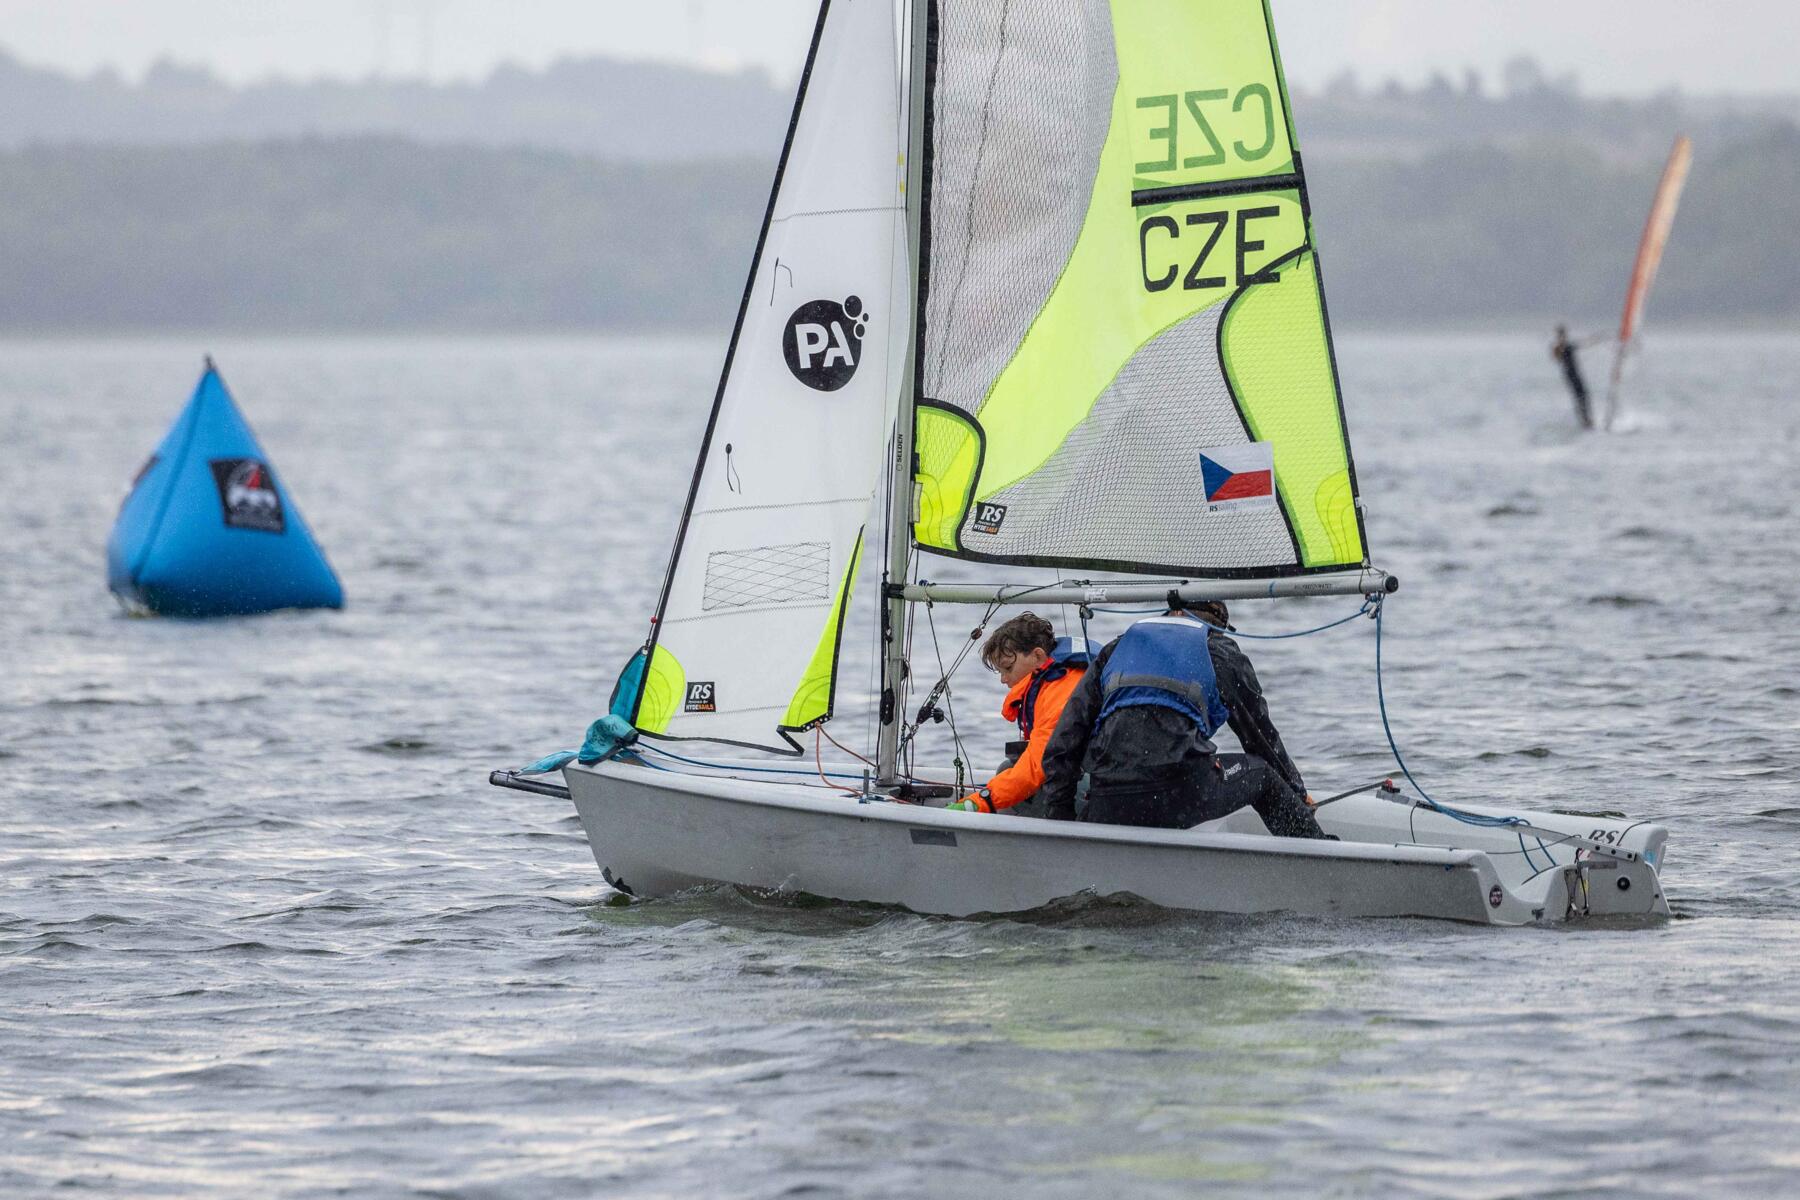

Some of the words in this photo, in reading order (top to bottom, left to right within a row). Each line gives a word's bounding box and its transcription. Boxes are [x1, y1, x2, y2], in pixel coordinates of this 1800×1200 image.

[1139, 205, 1281, 293] CZE
[795, 320, 855, 369] PA
[980, 505, 1004, 522] RS
[689, 683, 712, 700] RS
